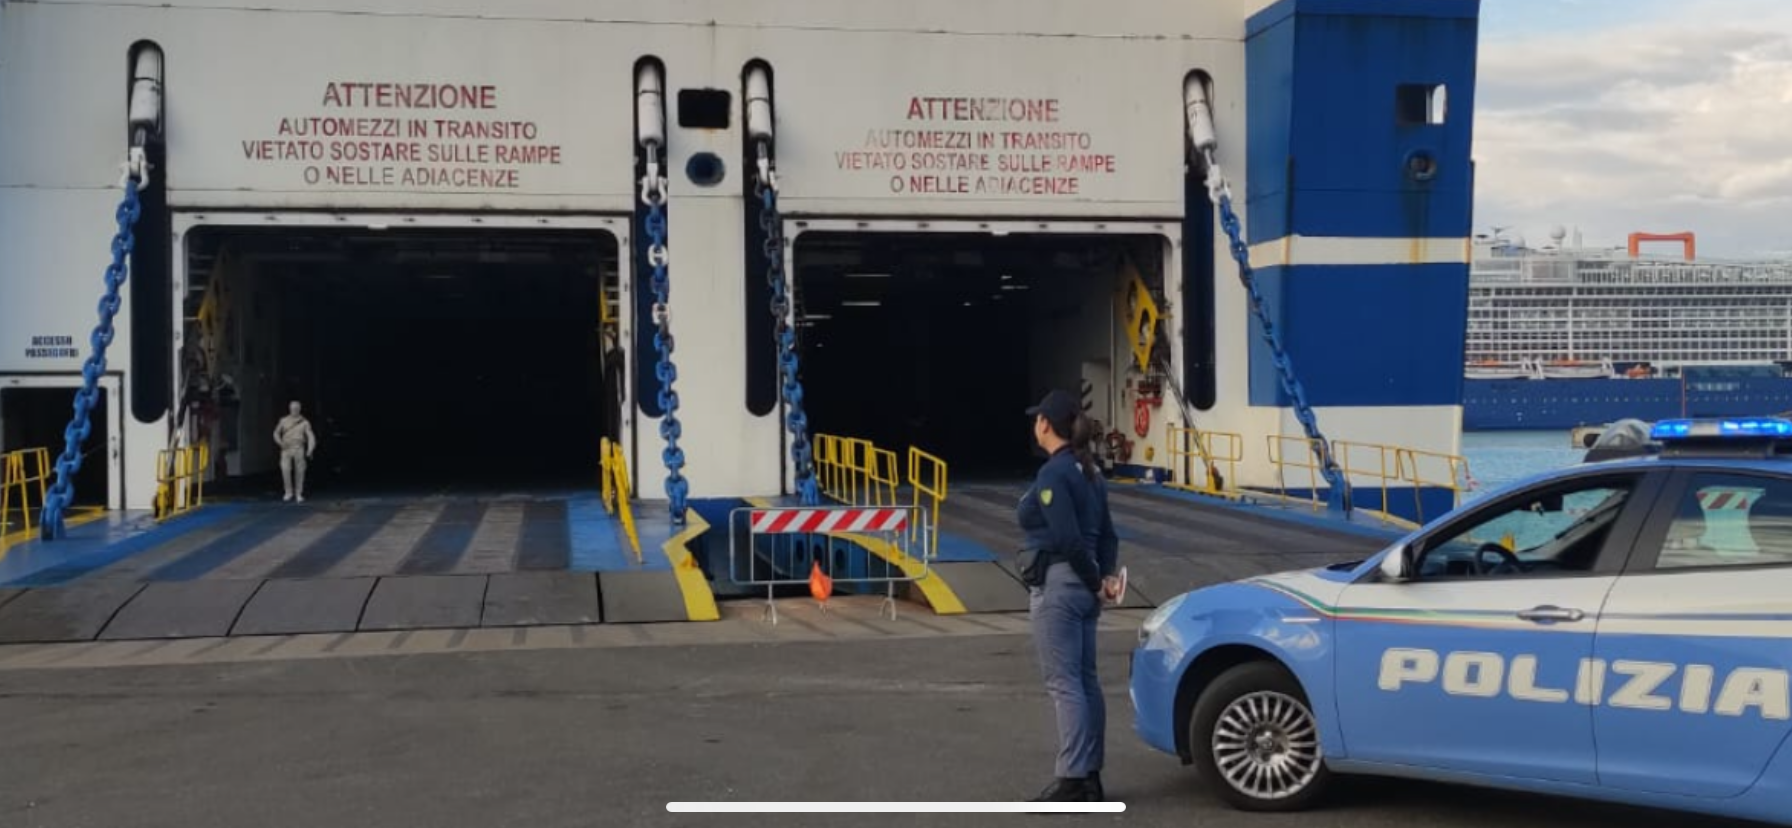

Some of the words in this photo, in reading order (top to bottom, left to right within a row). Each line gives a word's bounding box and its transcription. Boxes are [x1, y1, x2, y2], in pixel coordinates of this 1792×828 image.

[323, 82, 497, 109] ATTENZIONE
[907, 97, 1059, 122] ATTENZIONE
[278, 117, 400, 136] AUTOMEZZI
[408, 119, 427, 138] IN
[434, 120, 537, 139] TRANSITO
[865, 130, 971, 149] AUTOMEZZI
[978, 132, 995, 149] IN
[1001, 132, 1091, 150] TRANSITO
[243, 140, 324, 160] VIETATO
[330, 142, 421, 162] SOSTARE
[428, 144, 489, 163] SULLE
[495, 146, 561, 164] RAMPE
[835, 152, 906, 170] VIETATO
[912, 153, 989, 171] SOSTARE
[998, 154, 1051, 172] SULLE
[1057, 154, 1115, 173] RAMPE
[304, 166, 319, 184] O
[327, 166, 394, 185] NELLE
[402, 168, 519, 187] ADIACENZE
[891, 176, 903, 193] O
[910, 177, 969, 193] NELLE
[975, 177, 1079, 194] ADIACENZE
[1378, 647, 1790, 720] POLIZIA
